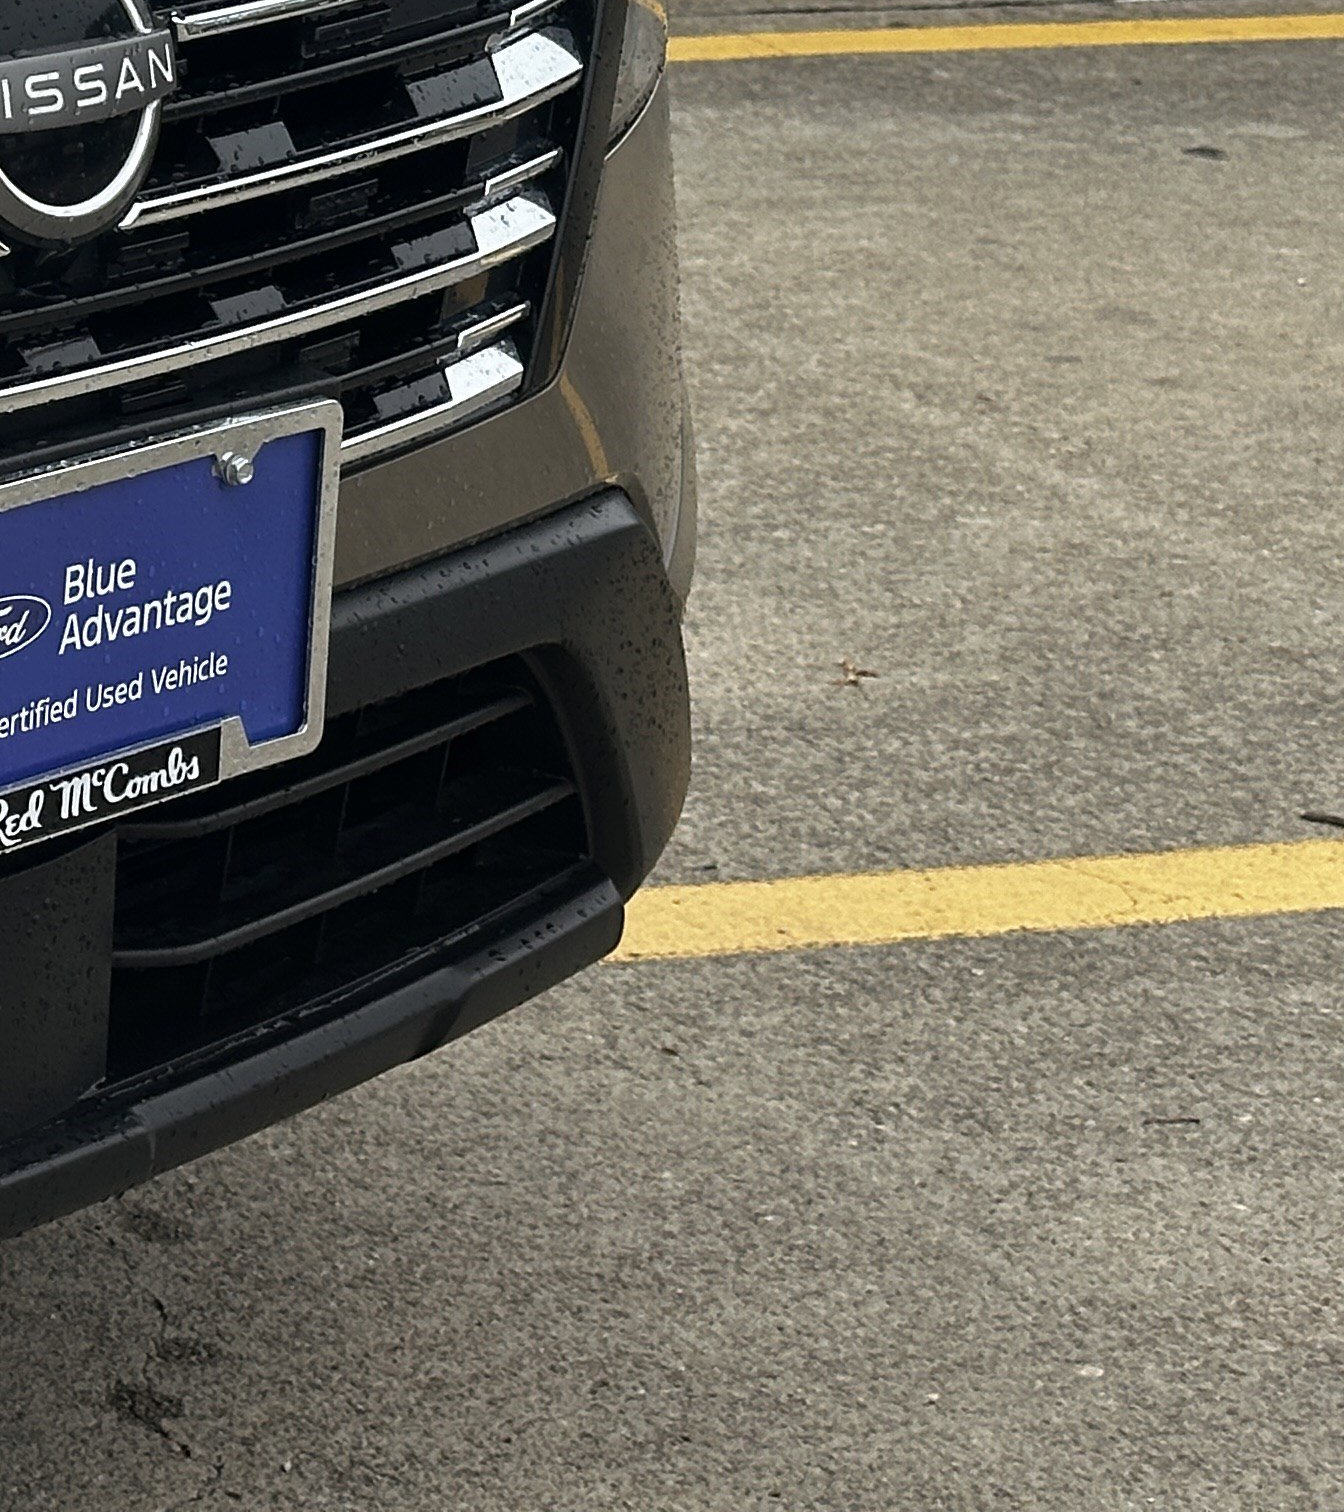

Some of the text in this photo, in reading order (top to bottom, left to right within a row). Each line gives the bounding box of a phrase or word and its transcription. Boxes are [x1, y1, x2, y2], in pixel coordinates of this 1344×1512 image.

[64, 558, 136, 605] Blue
[58, 580, 231, 654] Advantage
[86, 672, 142, 713] Used
[151, 652, 228, 694] Vehicle
[50, 747, 199, 819] McCombs
